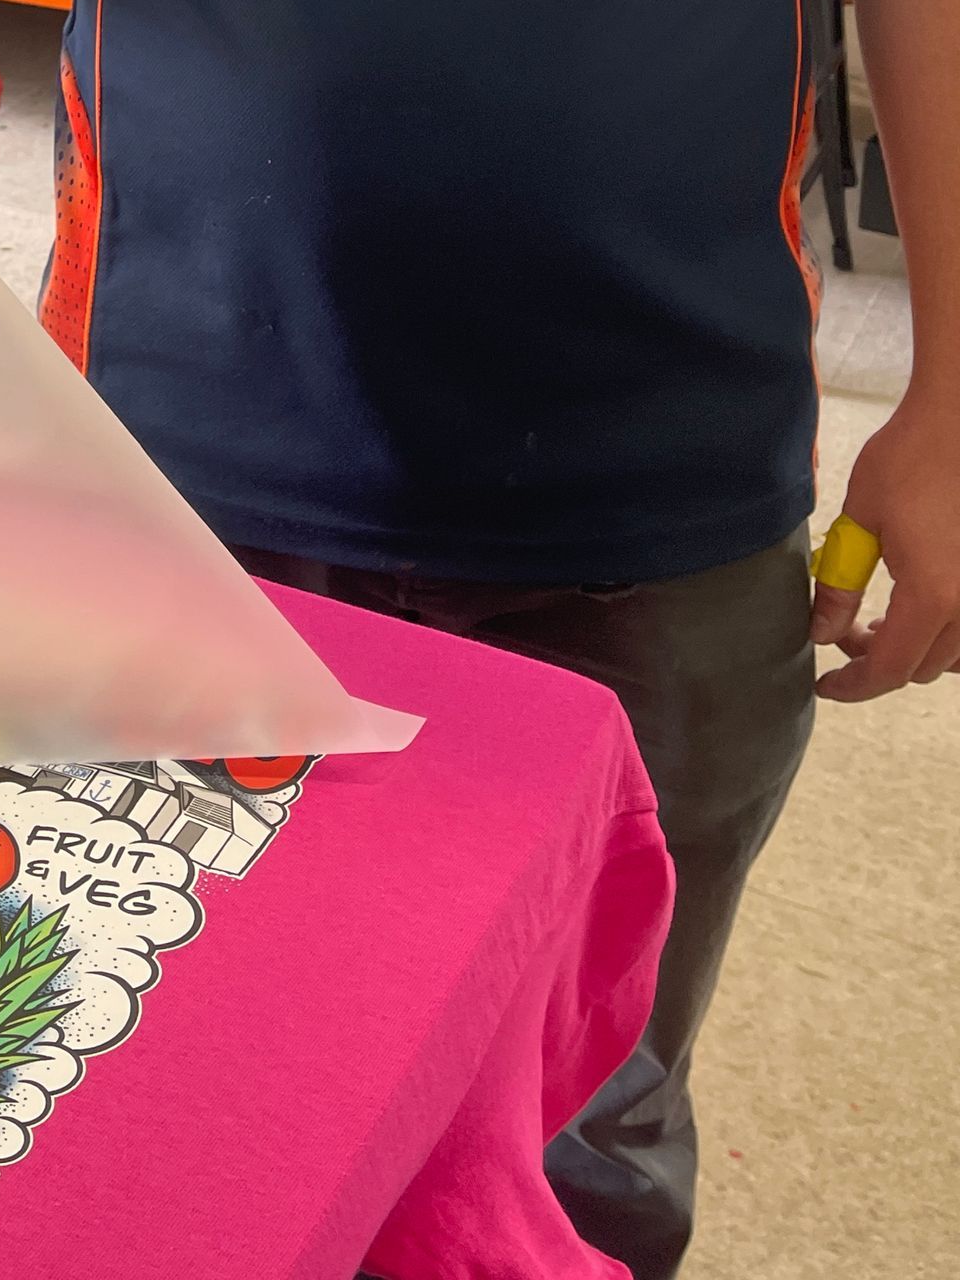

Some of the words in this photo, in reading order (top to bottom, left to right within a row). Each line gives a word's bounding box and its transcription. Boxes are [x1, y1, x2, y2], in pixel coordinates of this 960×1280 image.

[26, 825, 155, 874] FRUIT
[25, 860, 50, 880] &
[59, 870, 158, 916] VEG
